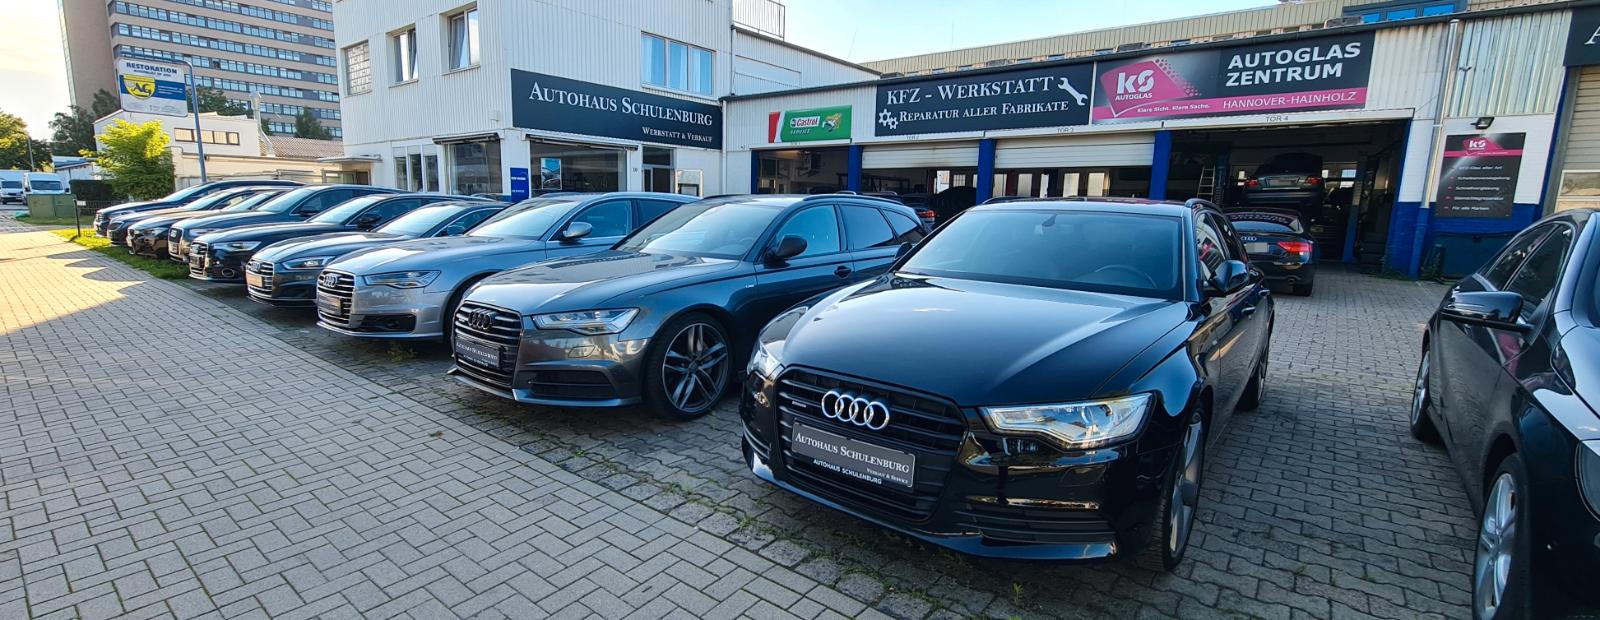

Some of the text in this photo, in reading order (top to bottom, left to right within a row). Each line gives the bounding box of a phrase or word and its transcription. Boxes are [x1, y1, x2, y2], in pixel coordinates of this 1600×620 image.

[1228, 42, 1361, 69] AUTOGLAS
[126, 62, 178, 74] RESTORATION
[1225, 63, 1343, 87] ZENTRUM
[886, 87, 921, 105] KFZ
[938, 76, 1054, 101] WERKSTATT
[1115, 92, 1153, 101] AUTOGLAS
[1223, 91, 1357, 109] HANNOVER-HAINHOLZ
[529, 82, 713, 126] AUTOHAUS SCHULENBURG
[899, 101, 1069, 122] REPARATUR ALLER FABRIKATE
[797, 117, 818, 127] Castrol
[642, 126, 681, 139] WERKSTATT
[687, 132, 713, 143] VERKAUF
[795, 432, 910, 473] AUTOHAUS SCHULENBURG
[813, 459, 882, 484] AUTOHAUS SCHULENBURG
